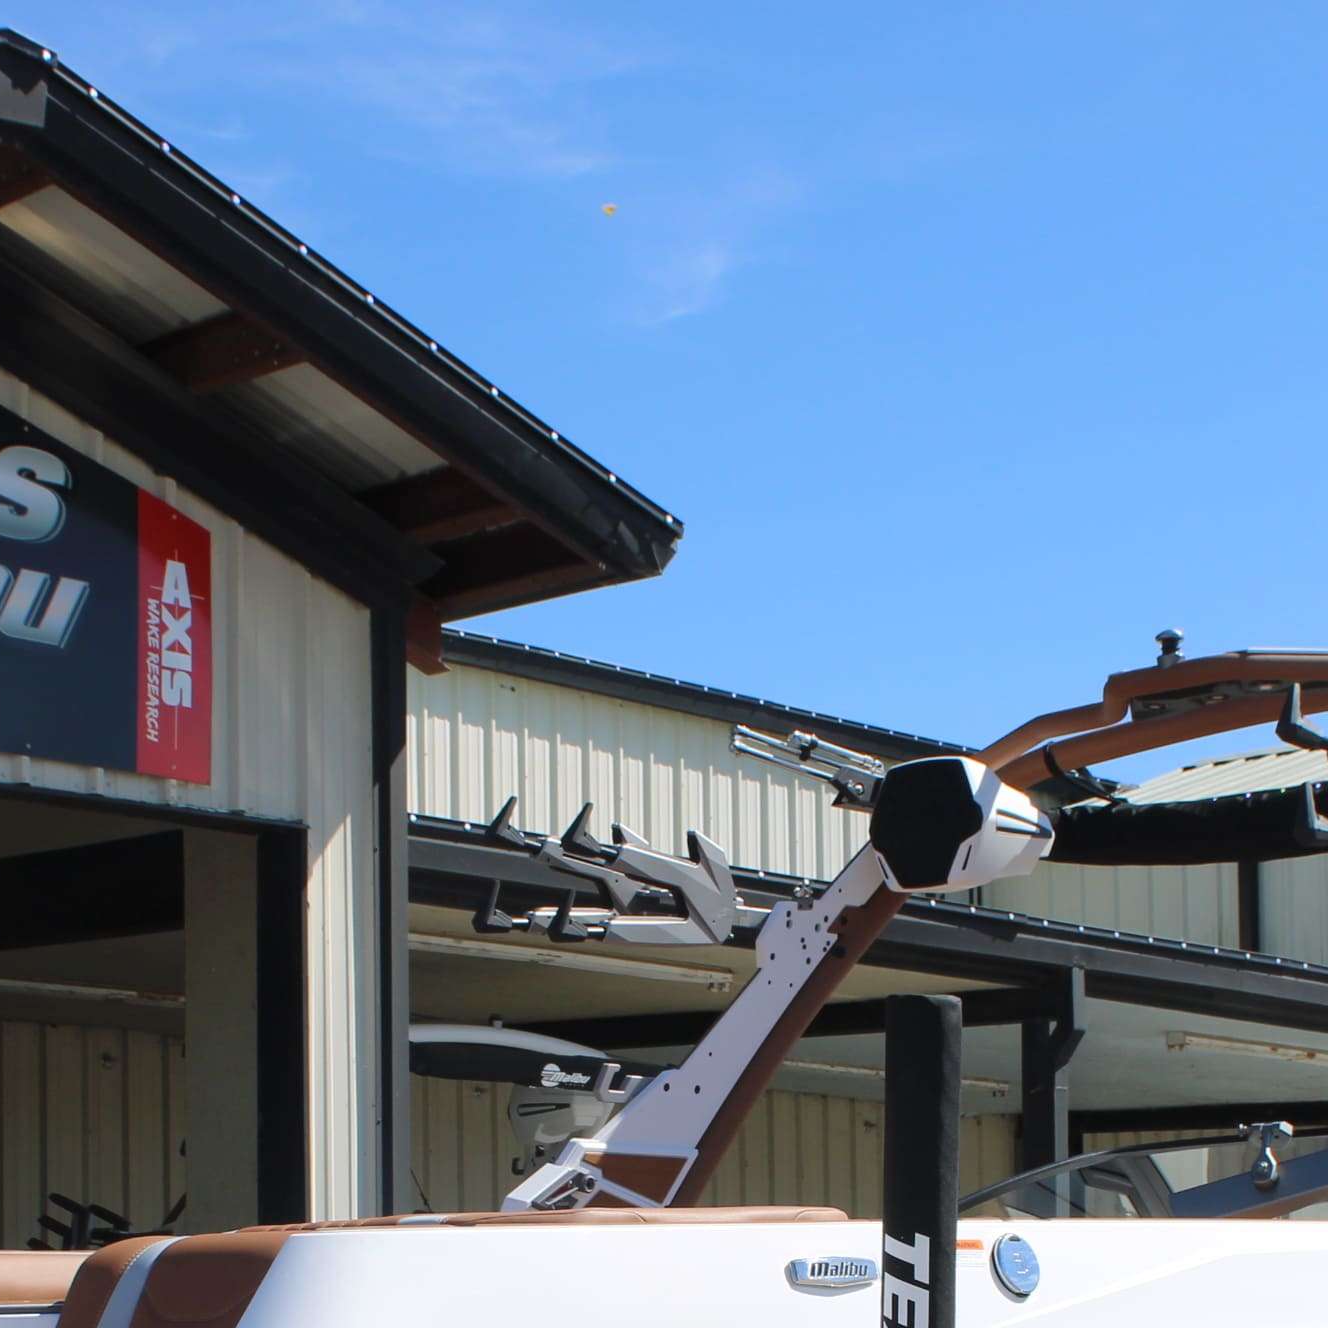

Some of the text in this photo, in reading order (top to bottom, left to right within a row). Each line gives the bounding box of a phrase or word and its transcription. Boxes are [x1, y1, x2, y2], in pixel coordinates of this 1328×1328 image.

[145, 598, 161, 743] WAKE RESEARCH
[160, 559, 192, 709] AXIS
[809, 1261, 868, 1278] Malibu
